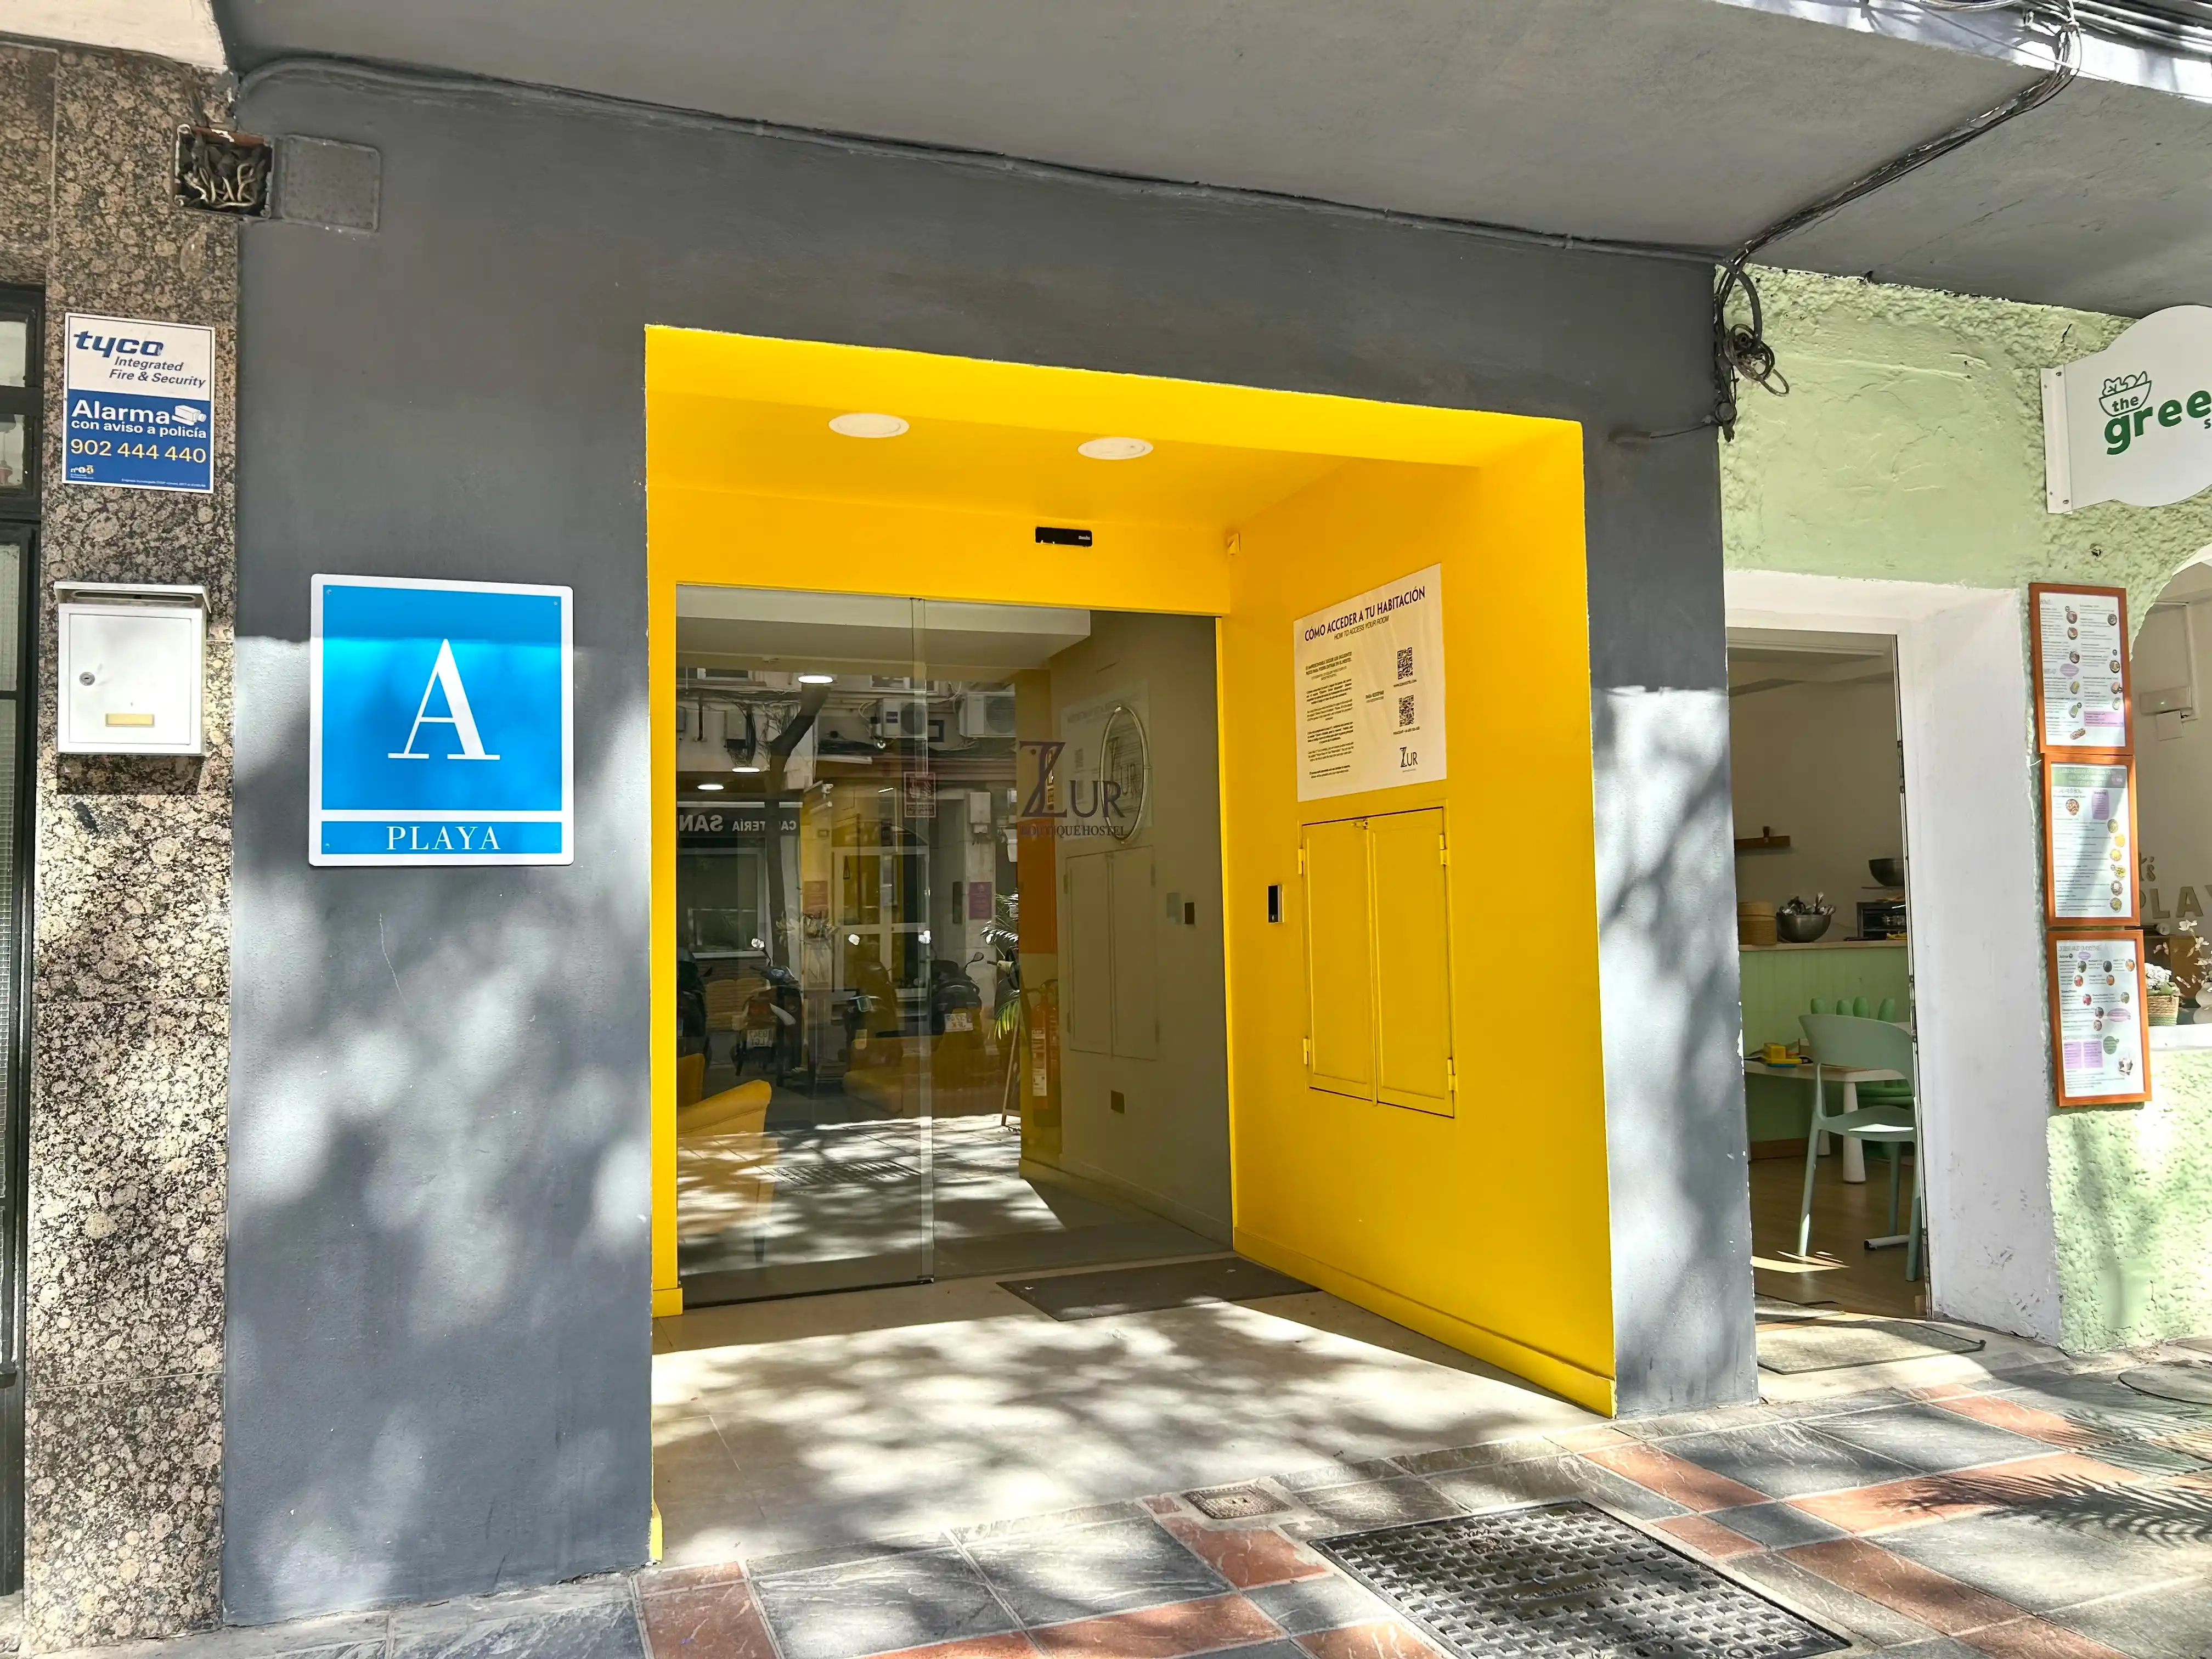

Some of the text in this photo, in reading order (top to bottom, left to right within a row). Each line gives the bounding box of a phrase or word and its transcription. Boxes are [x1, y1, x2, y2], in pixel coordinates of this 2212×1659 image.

[73, 331, 163, 357] tyco
[114, 356, 184, 371] Integrated
[109, 369, 206, 388] Fire & Security
[71, 399, 171, 424] Alarma
[2112, 395, 2139, 413] the
[71, 420, 206, 438] con aviso a policía
[71, 439, 206, 463] 902 444 440
[1305, 586, 1425, 641] CÓMO ACCEDER A TU HABITACIÓN
[388, 638, 500, 760] A
[386, 826, 500, 850] PLAYA
